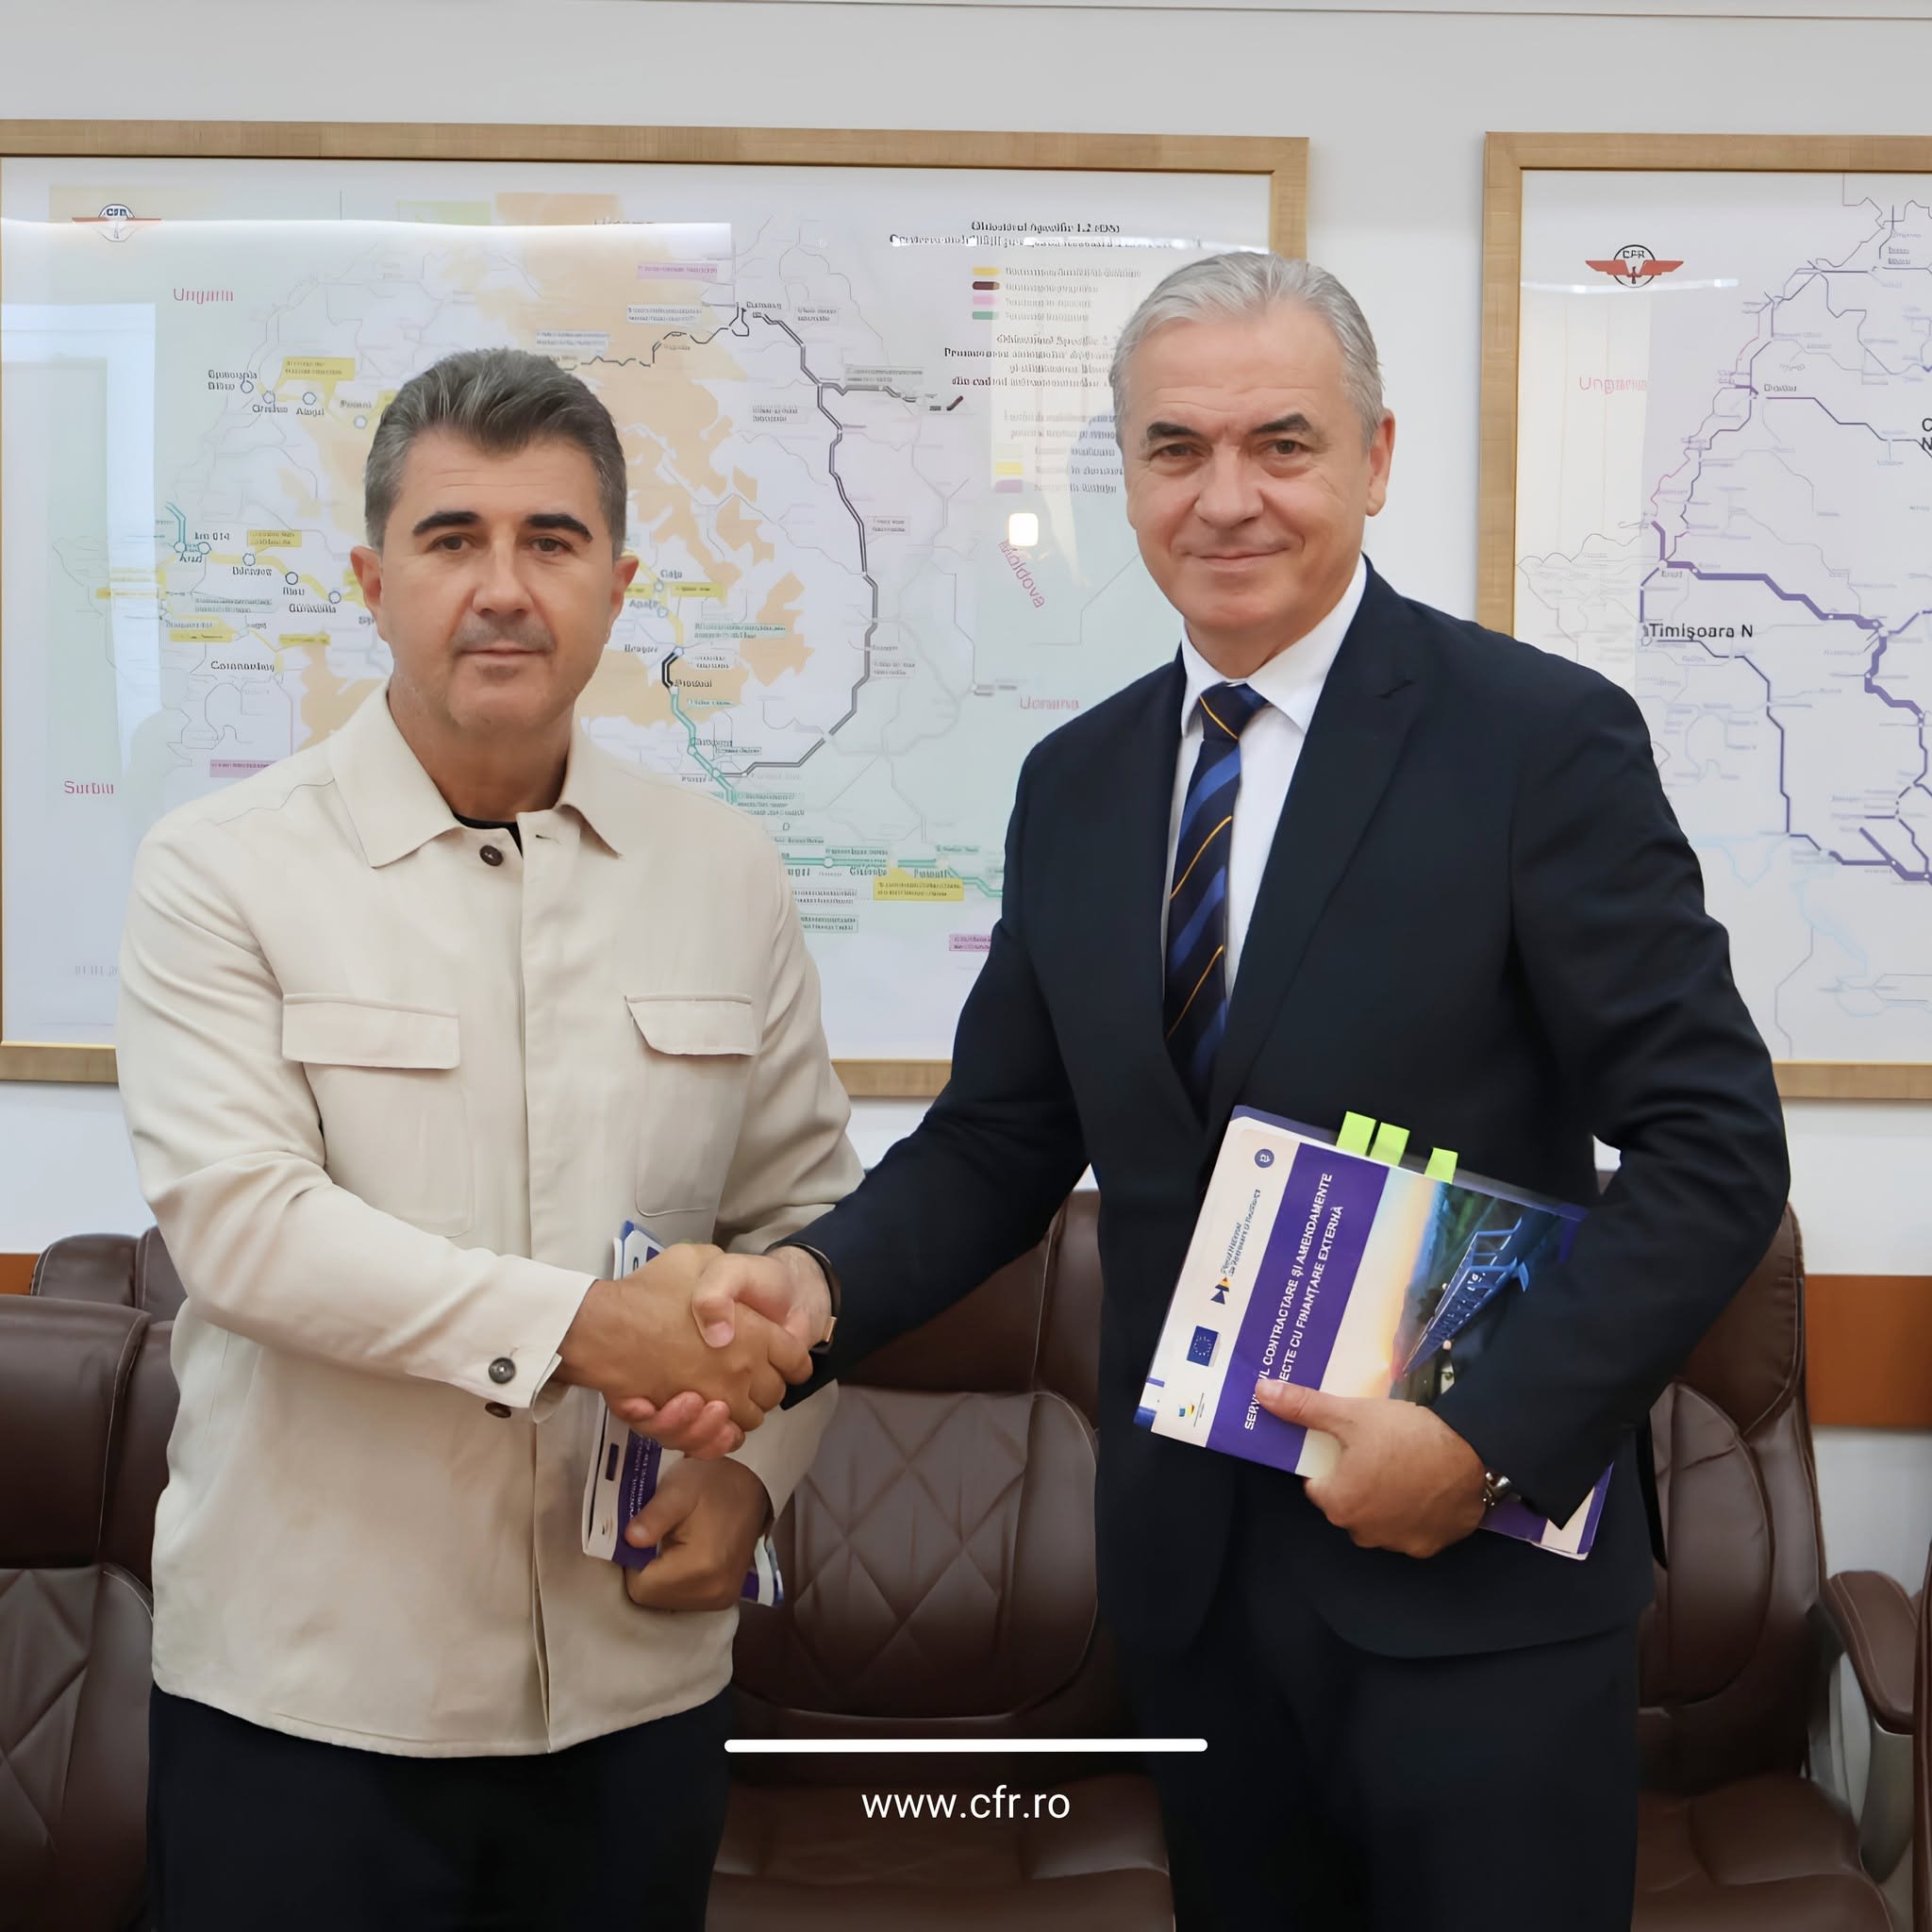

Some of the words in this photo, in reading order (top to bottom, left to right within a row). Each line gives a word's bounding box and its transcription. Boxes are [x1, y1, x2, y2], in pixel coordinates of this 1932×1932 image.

[1623, 250, 1646, 259] CFR
[1741, 625, 1753, 638] N
[1262, 1278, 1298, 1365] CONTRACTARE
[1295, 1173, 1332, 1264] AMENDAMENTE
[1290, 1329, 1303, 1347] CU
